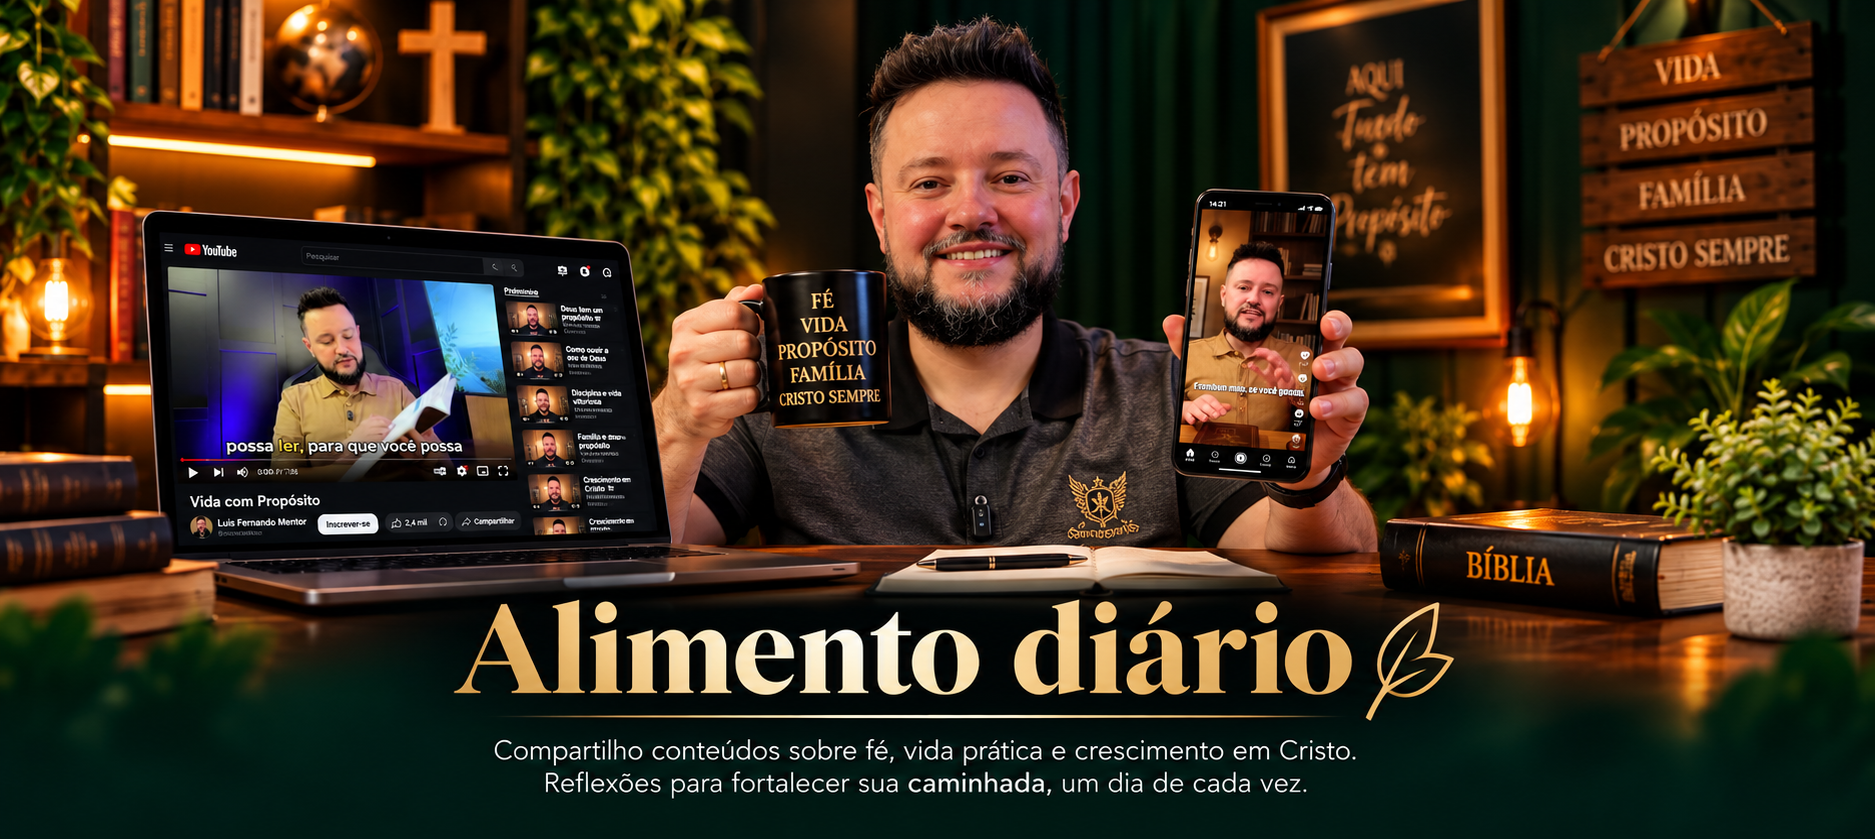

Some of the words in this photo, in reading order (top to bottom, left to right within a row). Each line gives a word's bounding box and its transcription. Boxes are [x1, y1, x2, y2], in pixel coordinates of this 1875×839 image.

[1654, 51, 1722, 86] VIDA
[1345, 58, 1404, 102] AQUI
[1619, 107, 1768, 151] PROPÓSITO
[1638, 169, 1747, 210] FAMÍLIA
[202, 244, 238, 257] YouTube
[1604, 240, 1689, 274] CRISTO
[1694, 234, 1791, 269] SEMPRE
[811, 288, 835, 310] FÉ
[800, 316, 848, 333] VIDA
[778, 336, 877, 361] PROPÓSITO
[790, 361, 866, 384] FAMÍLIA
[779, 391, 825, 406] CRISTO
[828, 389, 881, 405] SEMPRE
[226, 441, 274, 455] possa
[278, 439, 304, 454] ler,
[308, 441, 344, 455] para
[347, 441, 377, 455] que
[381, 439, 416, 453] você
[421, 441, 463, 455] possa
[190, 495, 221, 508] Vida
[224, 497, 253, 507] com
[257, 494, 320, 509] Propósito
[217, 518, 235, 527] Luis
[237, 518, 276, 527] Fernando
[278, 517, 307, 526] Mentor
[326, 520, 370, 529] Inscrever-se
[417, 518, 428, 526] mil
[1466, 545, 1555, 586] BÍBLIA
